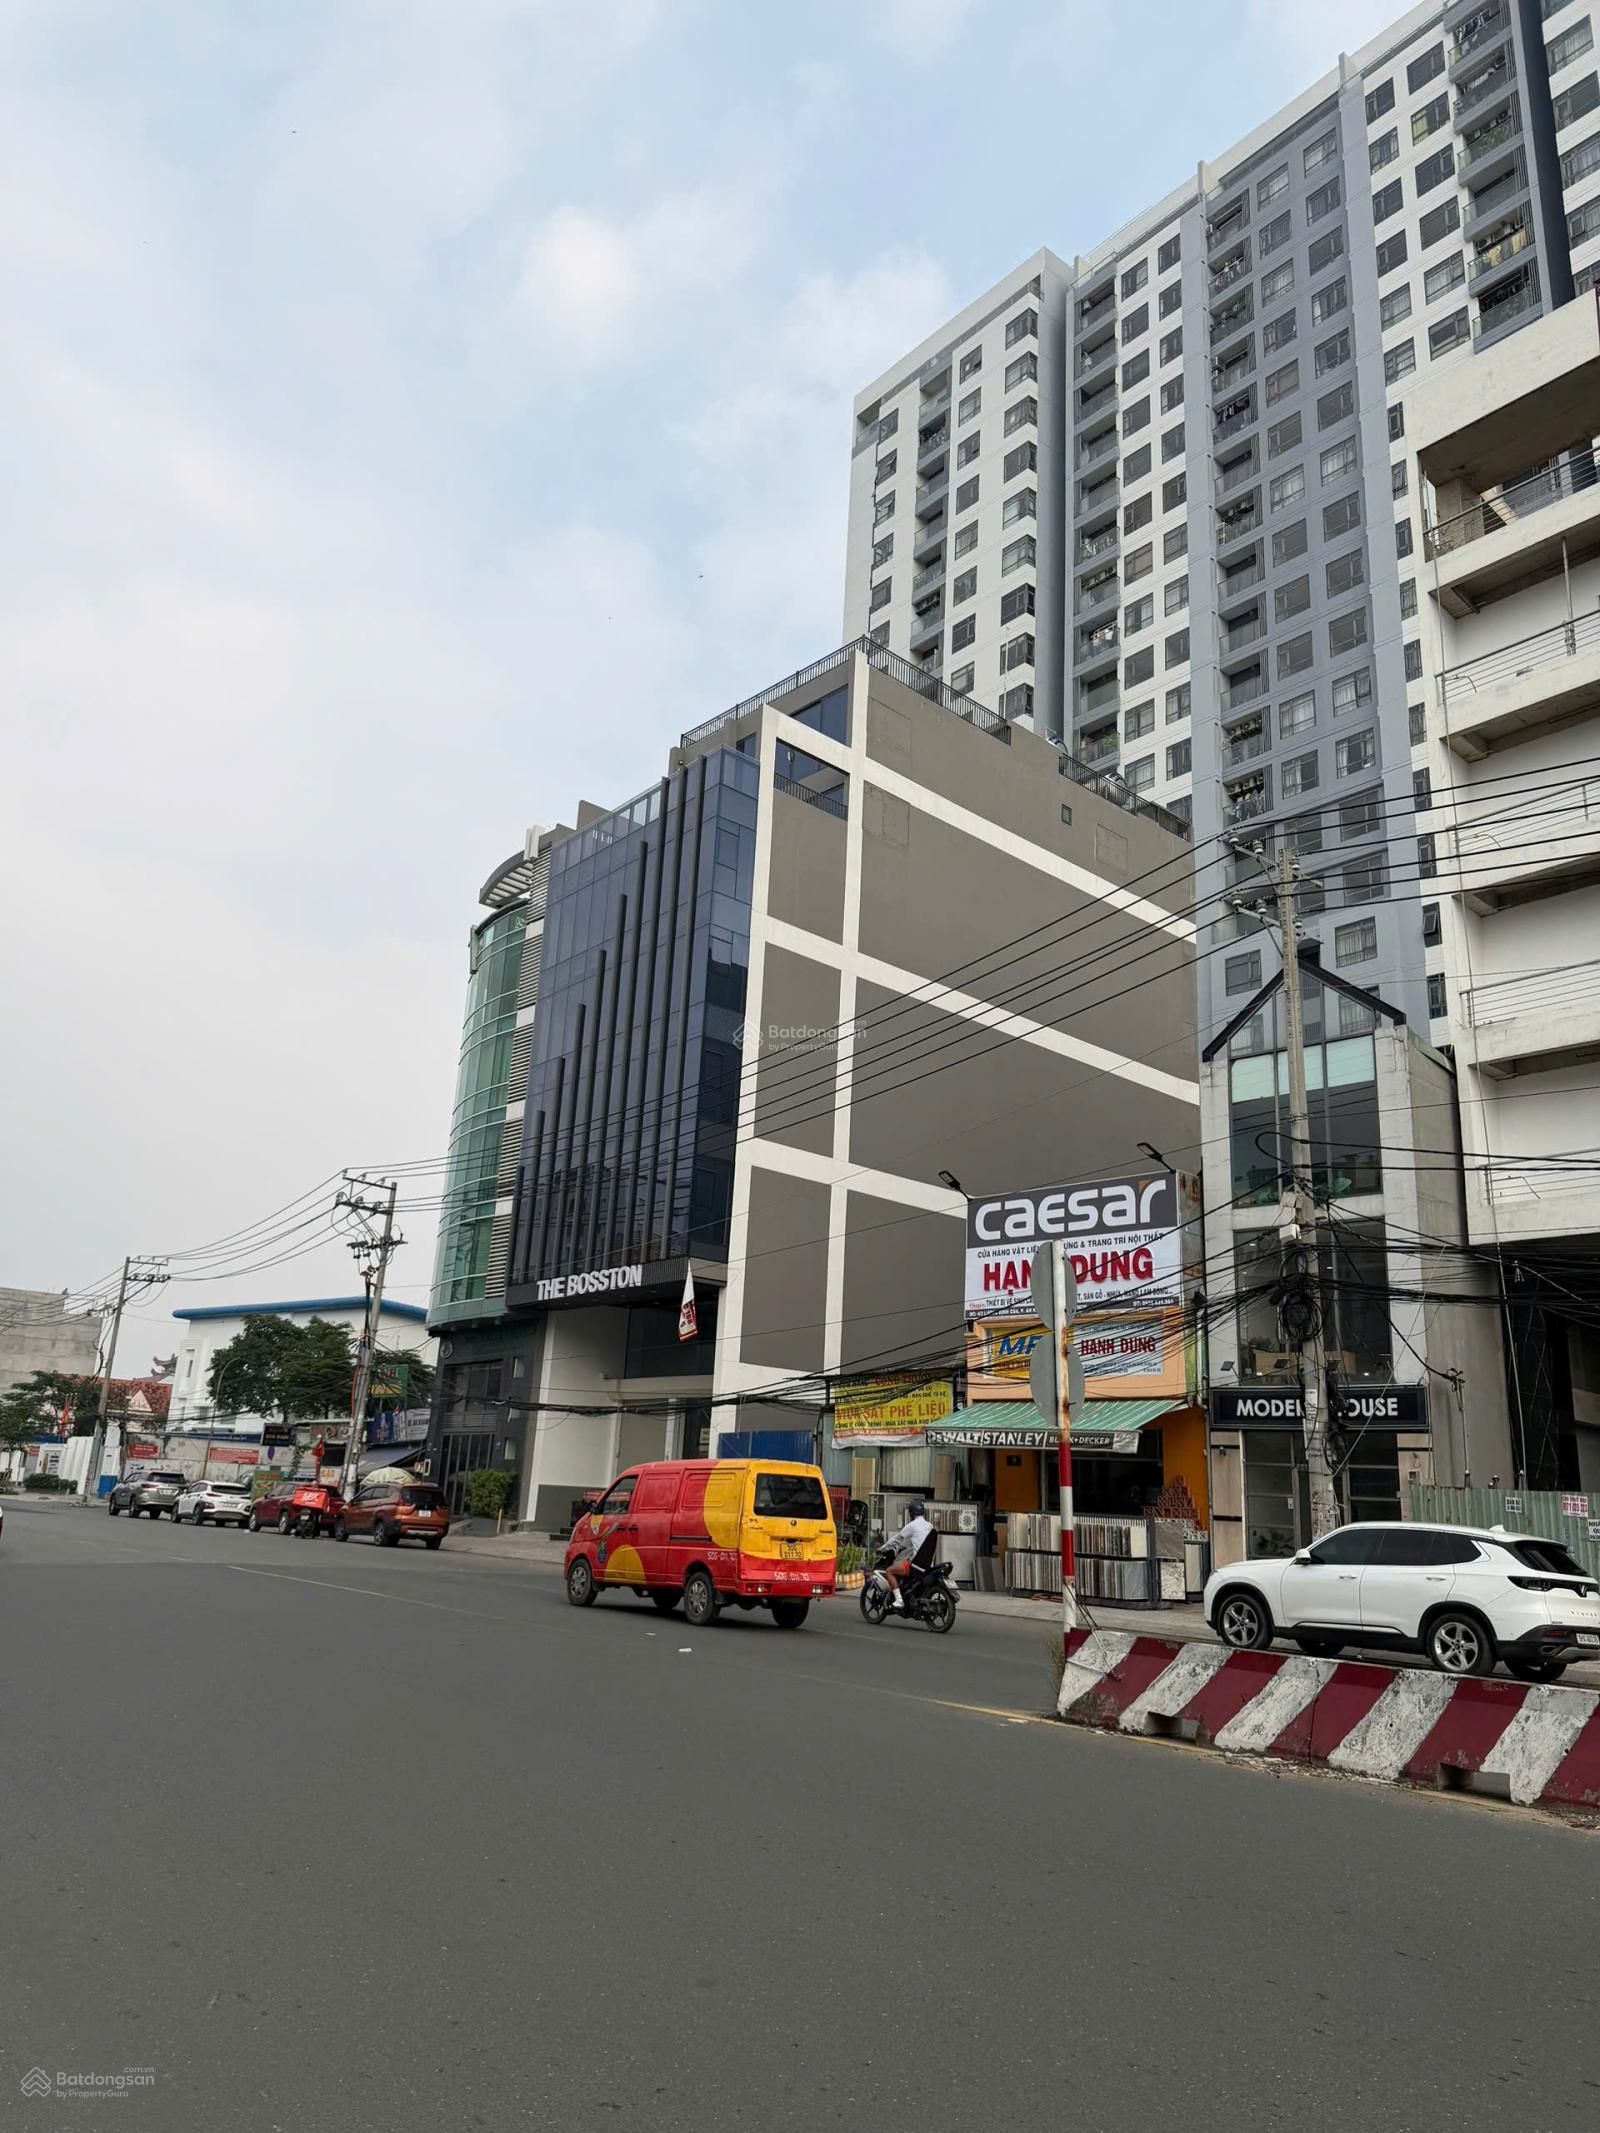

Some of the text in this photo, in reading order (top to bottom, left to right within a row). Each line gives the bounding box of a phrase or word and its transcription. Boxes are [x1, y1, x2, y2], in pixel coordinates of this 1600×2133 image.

[975, 1179, 1167, 1240] caesar
[1080, 1240, 1086, 1248] &
[1088, 1238, 1112, 1248] TRANG
[1113, 1235, 1126, 1245] TRÍ
[1128, 1235, 1141, 1246] NỘI
[536, 1264, 643, 1300] THE BOSSTON
[983, 1247, 1154, 1296] HẠN DUNG
[1236, 1398, 1306, 1417] MODE
[1338, 1397, 1399, 1417] OUSE
[983, 1431, 1044, 1446] STANLEY
